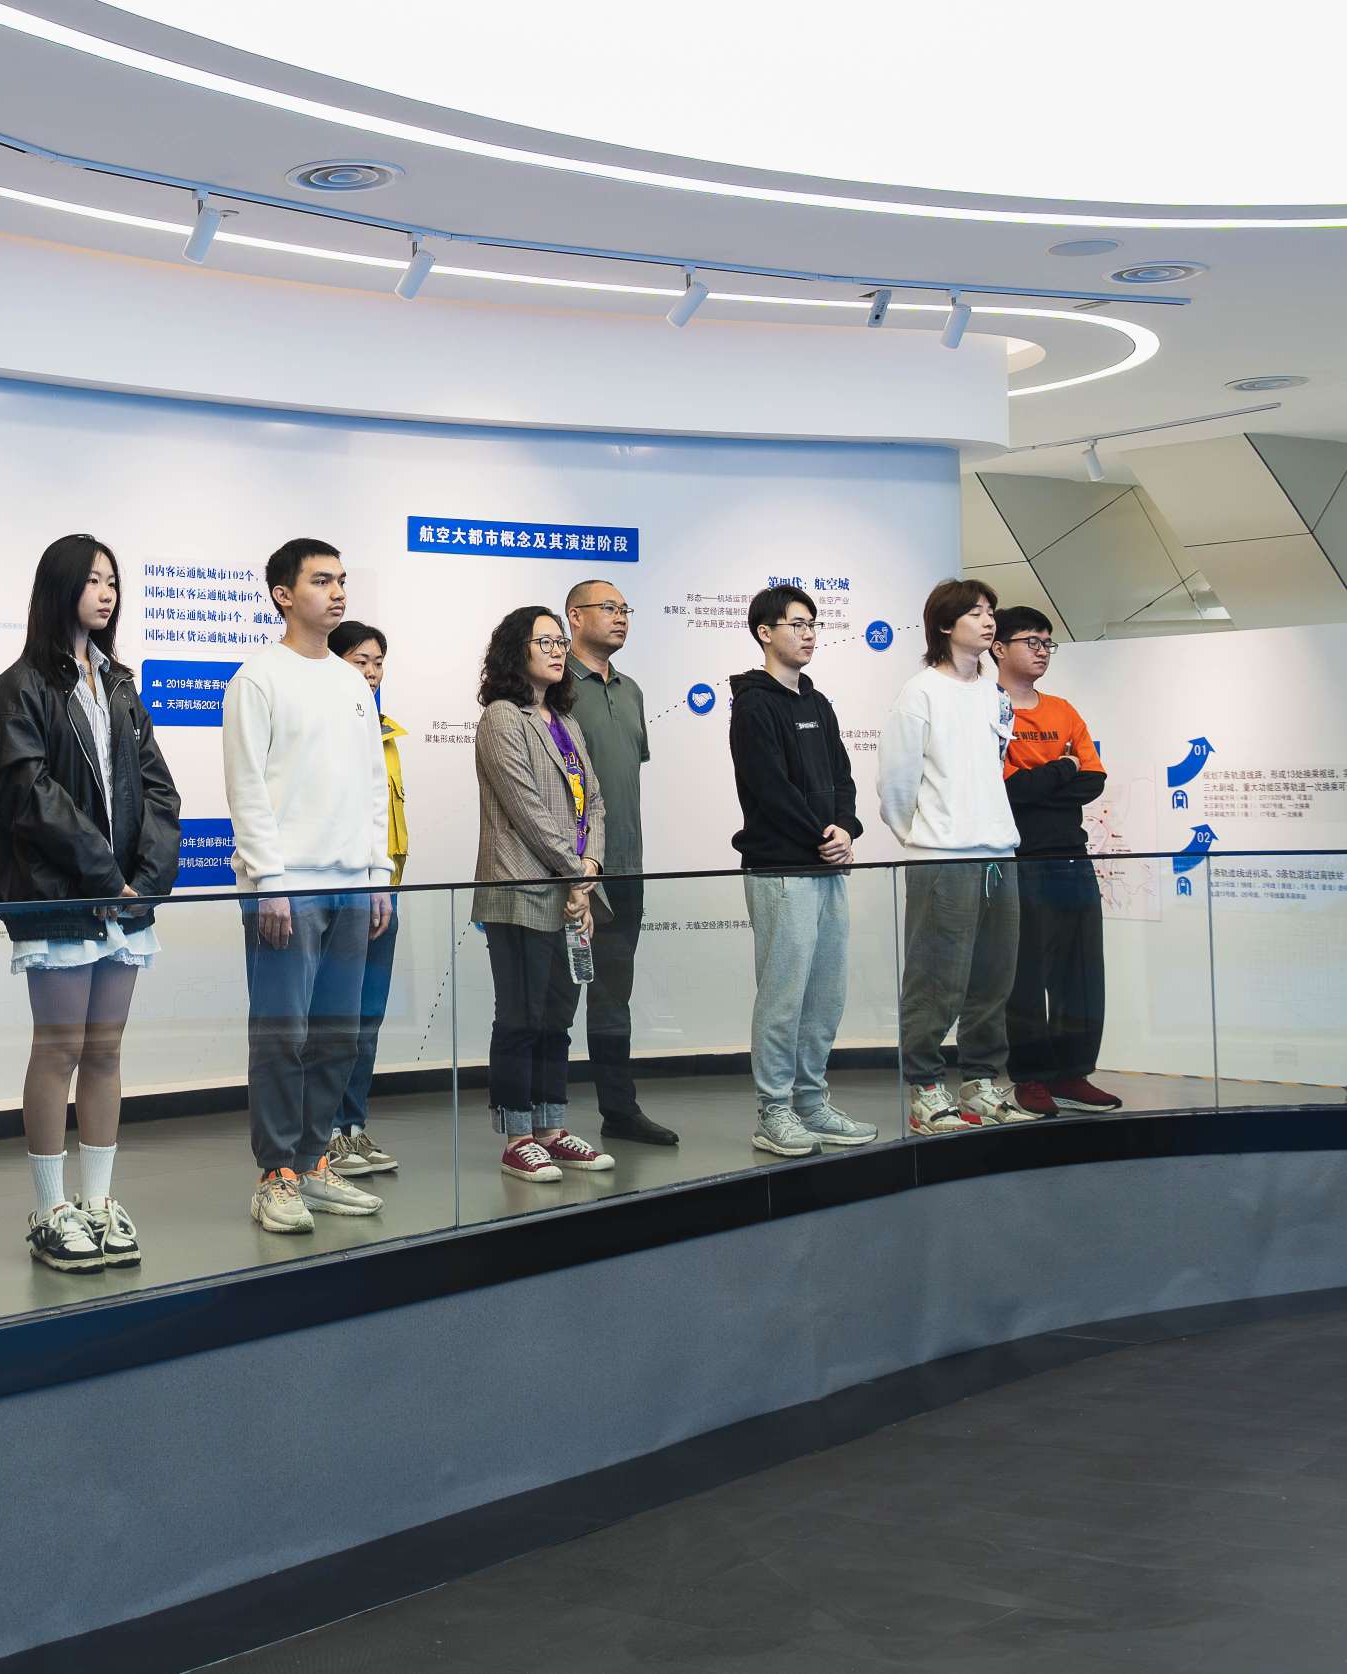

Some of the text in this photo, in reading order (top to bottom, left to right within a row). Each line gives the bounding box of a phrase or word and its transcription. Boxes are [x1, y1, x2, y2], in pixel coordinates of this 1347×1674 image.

[419, 525, 628, 553] 航空大都市概念及其演进阶段
[144, 607, 286, 625] 国内货运通航城市4个，通航点
[166, 699, 224, 710] 天河机场2021
[1193, 744, 1207, 756] 01
[1197, 832, 1211, 843] 02
